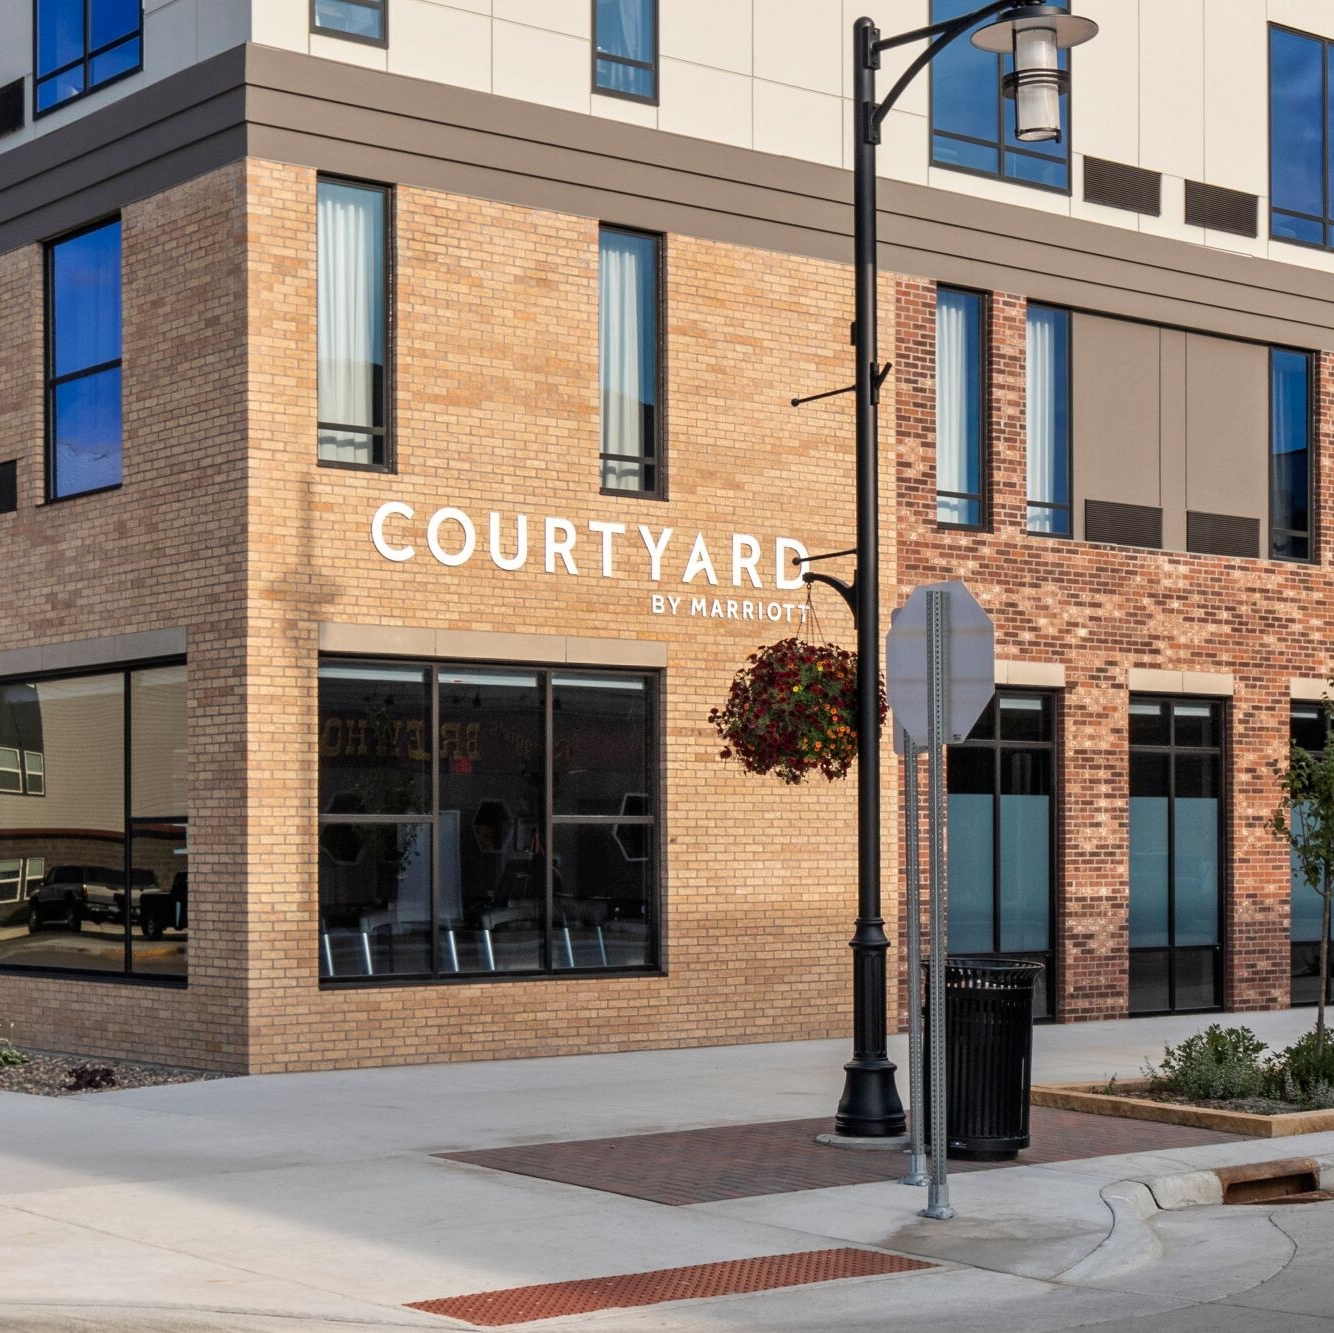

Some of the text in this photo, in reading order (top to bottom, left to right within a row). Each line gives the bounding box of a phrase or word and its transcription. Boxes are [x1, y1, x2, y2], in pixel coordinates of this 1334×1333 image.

[371, 501, 810, 590] COURTYARD
[652, 594, 810, 623] BY MARRIOTT
